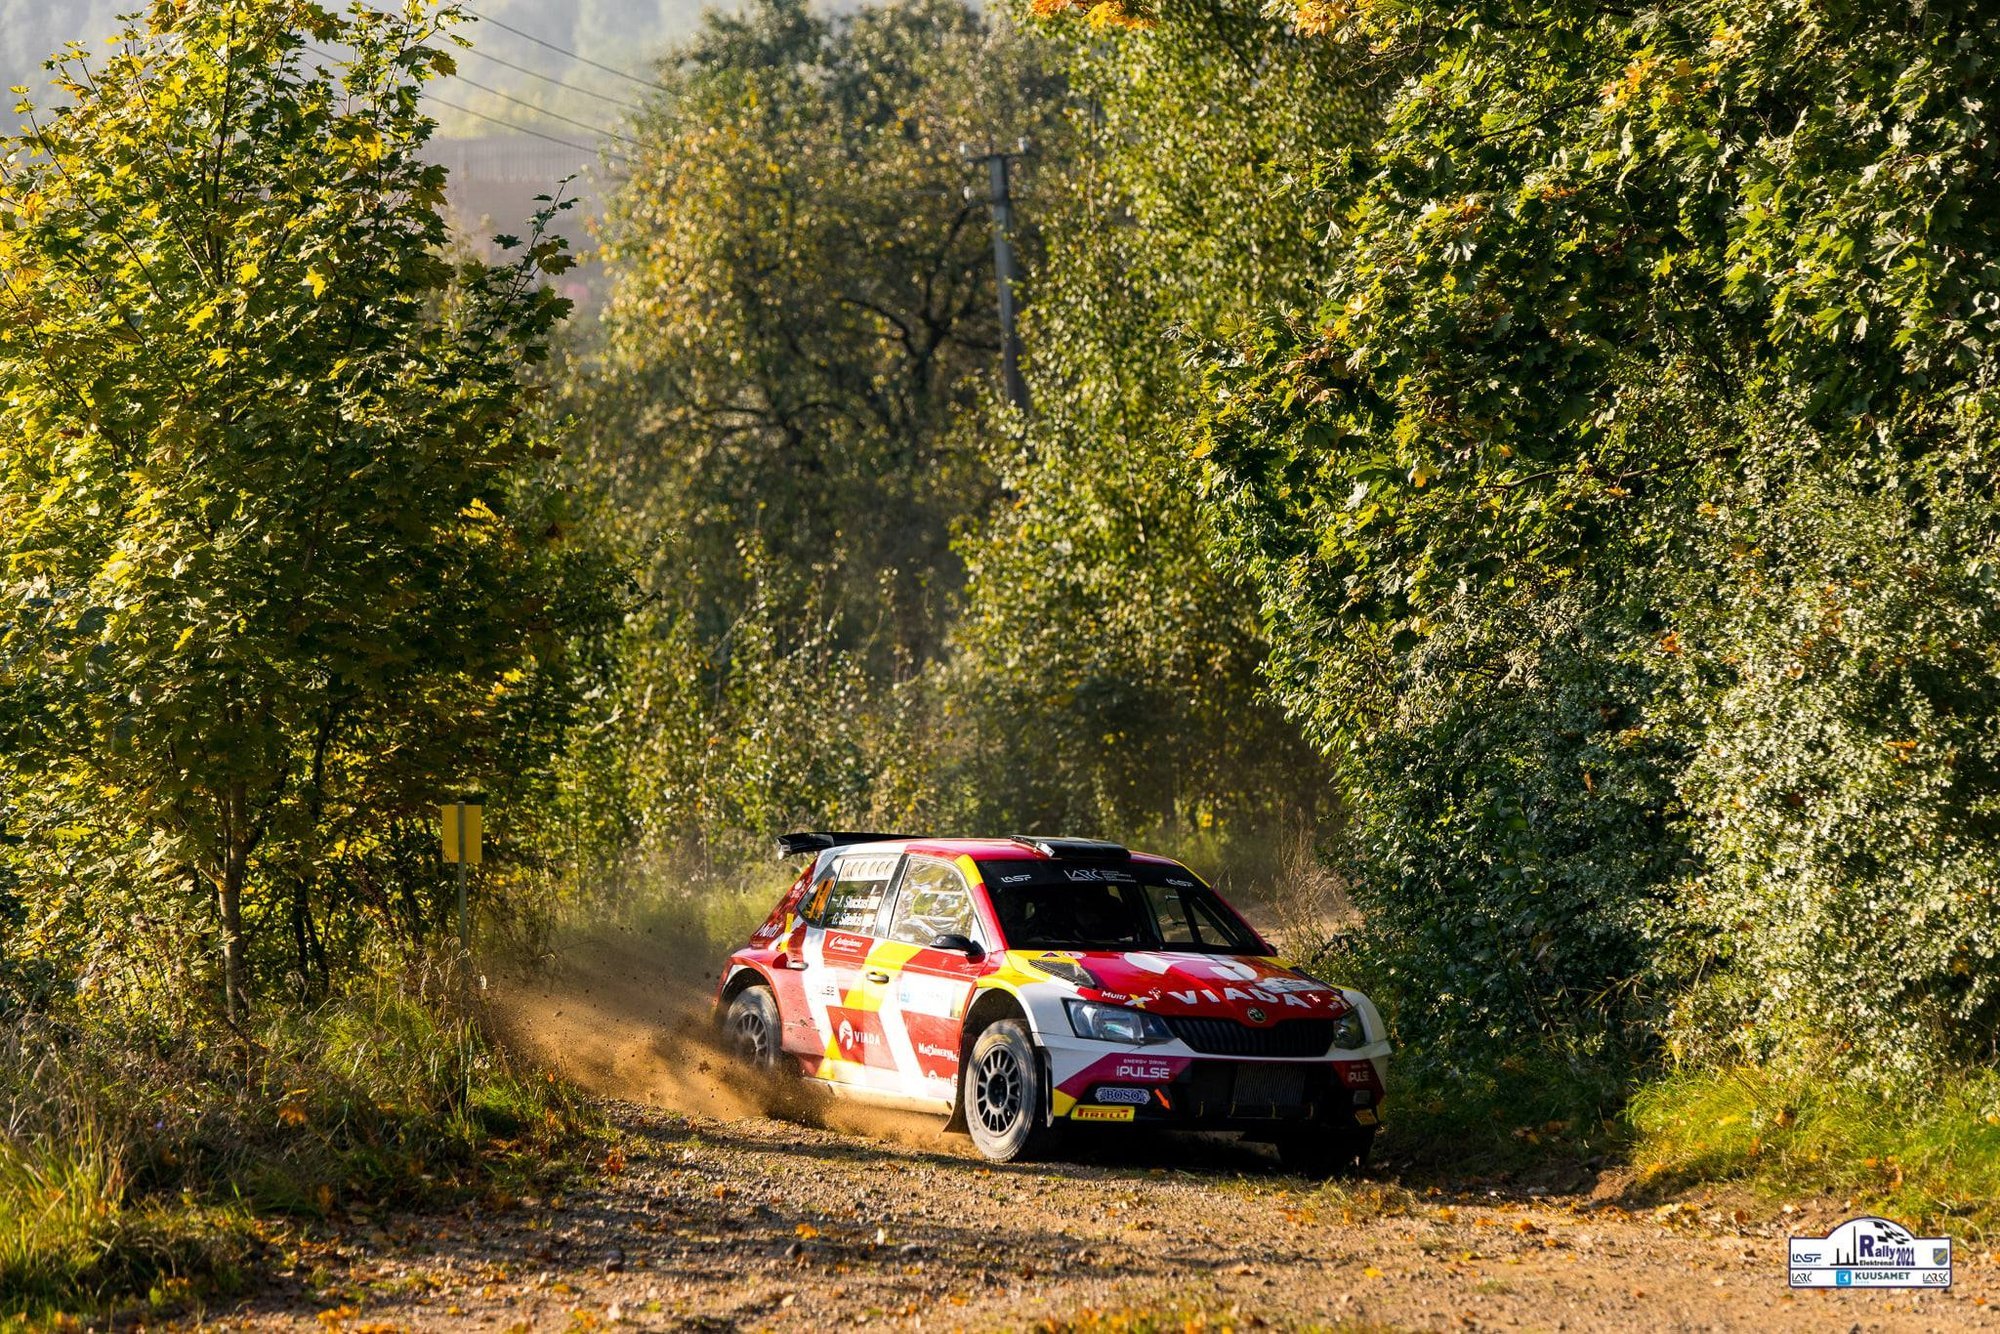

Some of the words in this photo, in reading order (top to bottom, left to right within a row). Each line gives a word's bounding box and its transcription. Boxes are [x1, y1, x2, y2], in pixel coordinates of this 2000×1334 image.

[1101, 990, 1127, 1001] Multi
[1167, 987, 1312, 1009] VIADA
[853, 1030, 881, 1046] VIADA
[1116, 1065, 1170, 1079] iPULSE
[1077, 1108, 1129, 1119] PIRELLI
